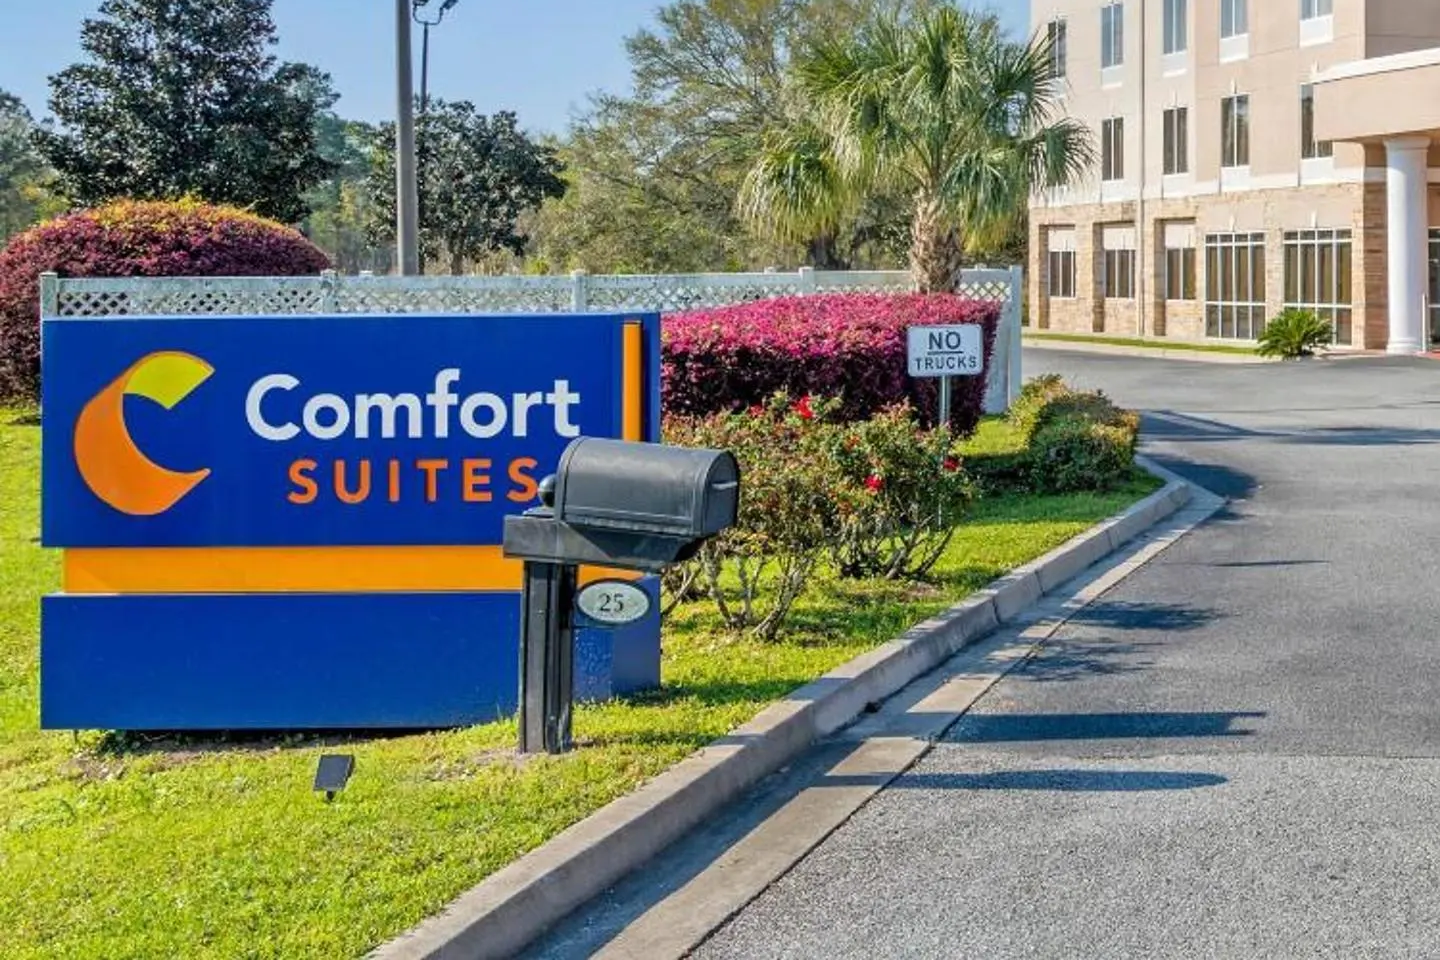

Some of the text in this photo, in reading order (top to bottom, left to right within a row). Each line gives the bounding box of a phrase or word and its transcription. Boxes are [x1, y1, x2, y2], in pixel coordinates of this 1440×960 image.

[928, 331, 961, 350] NO
[916, 356, 977, 370] TRUCKS
[245, 368, 581, 441] Comfort
[287, 457, 539, 504] SUITES
[599, 592, 624, 612] 25
